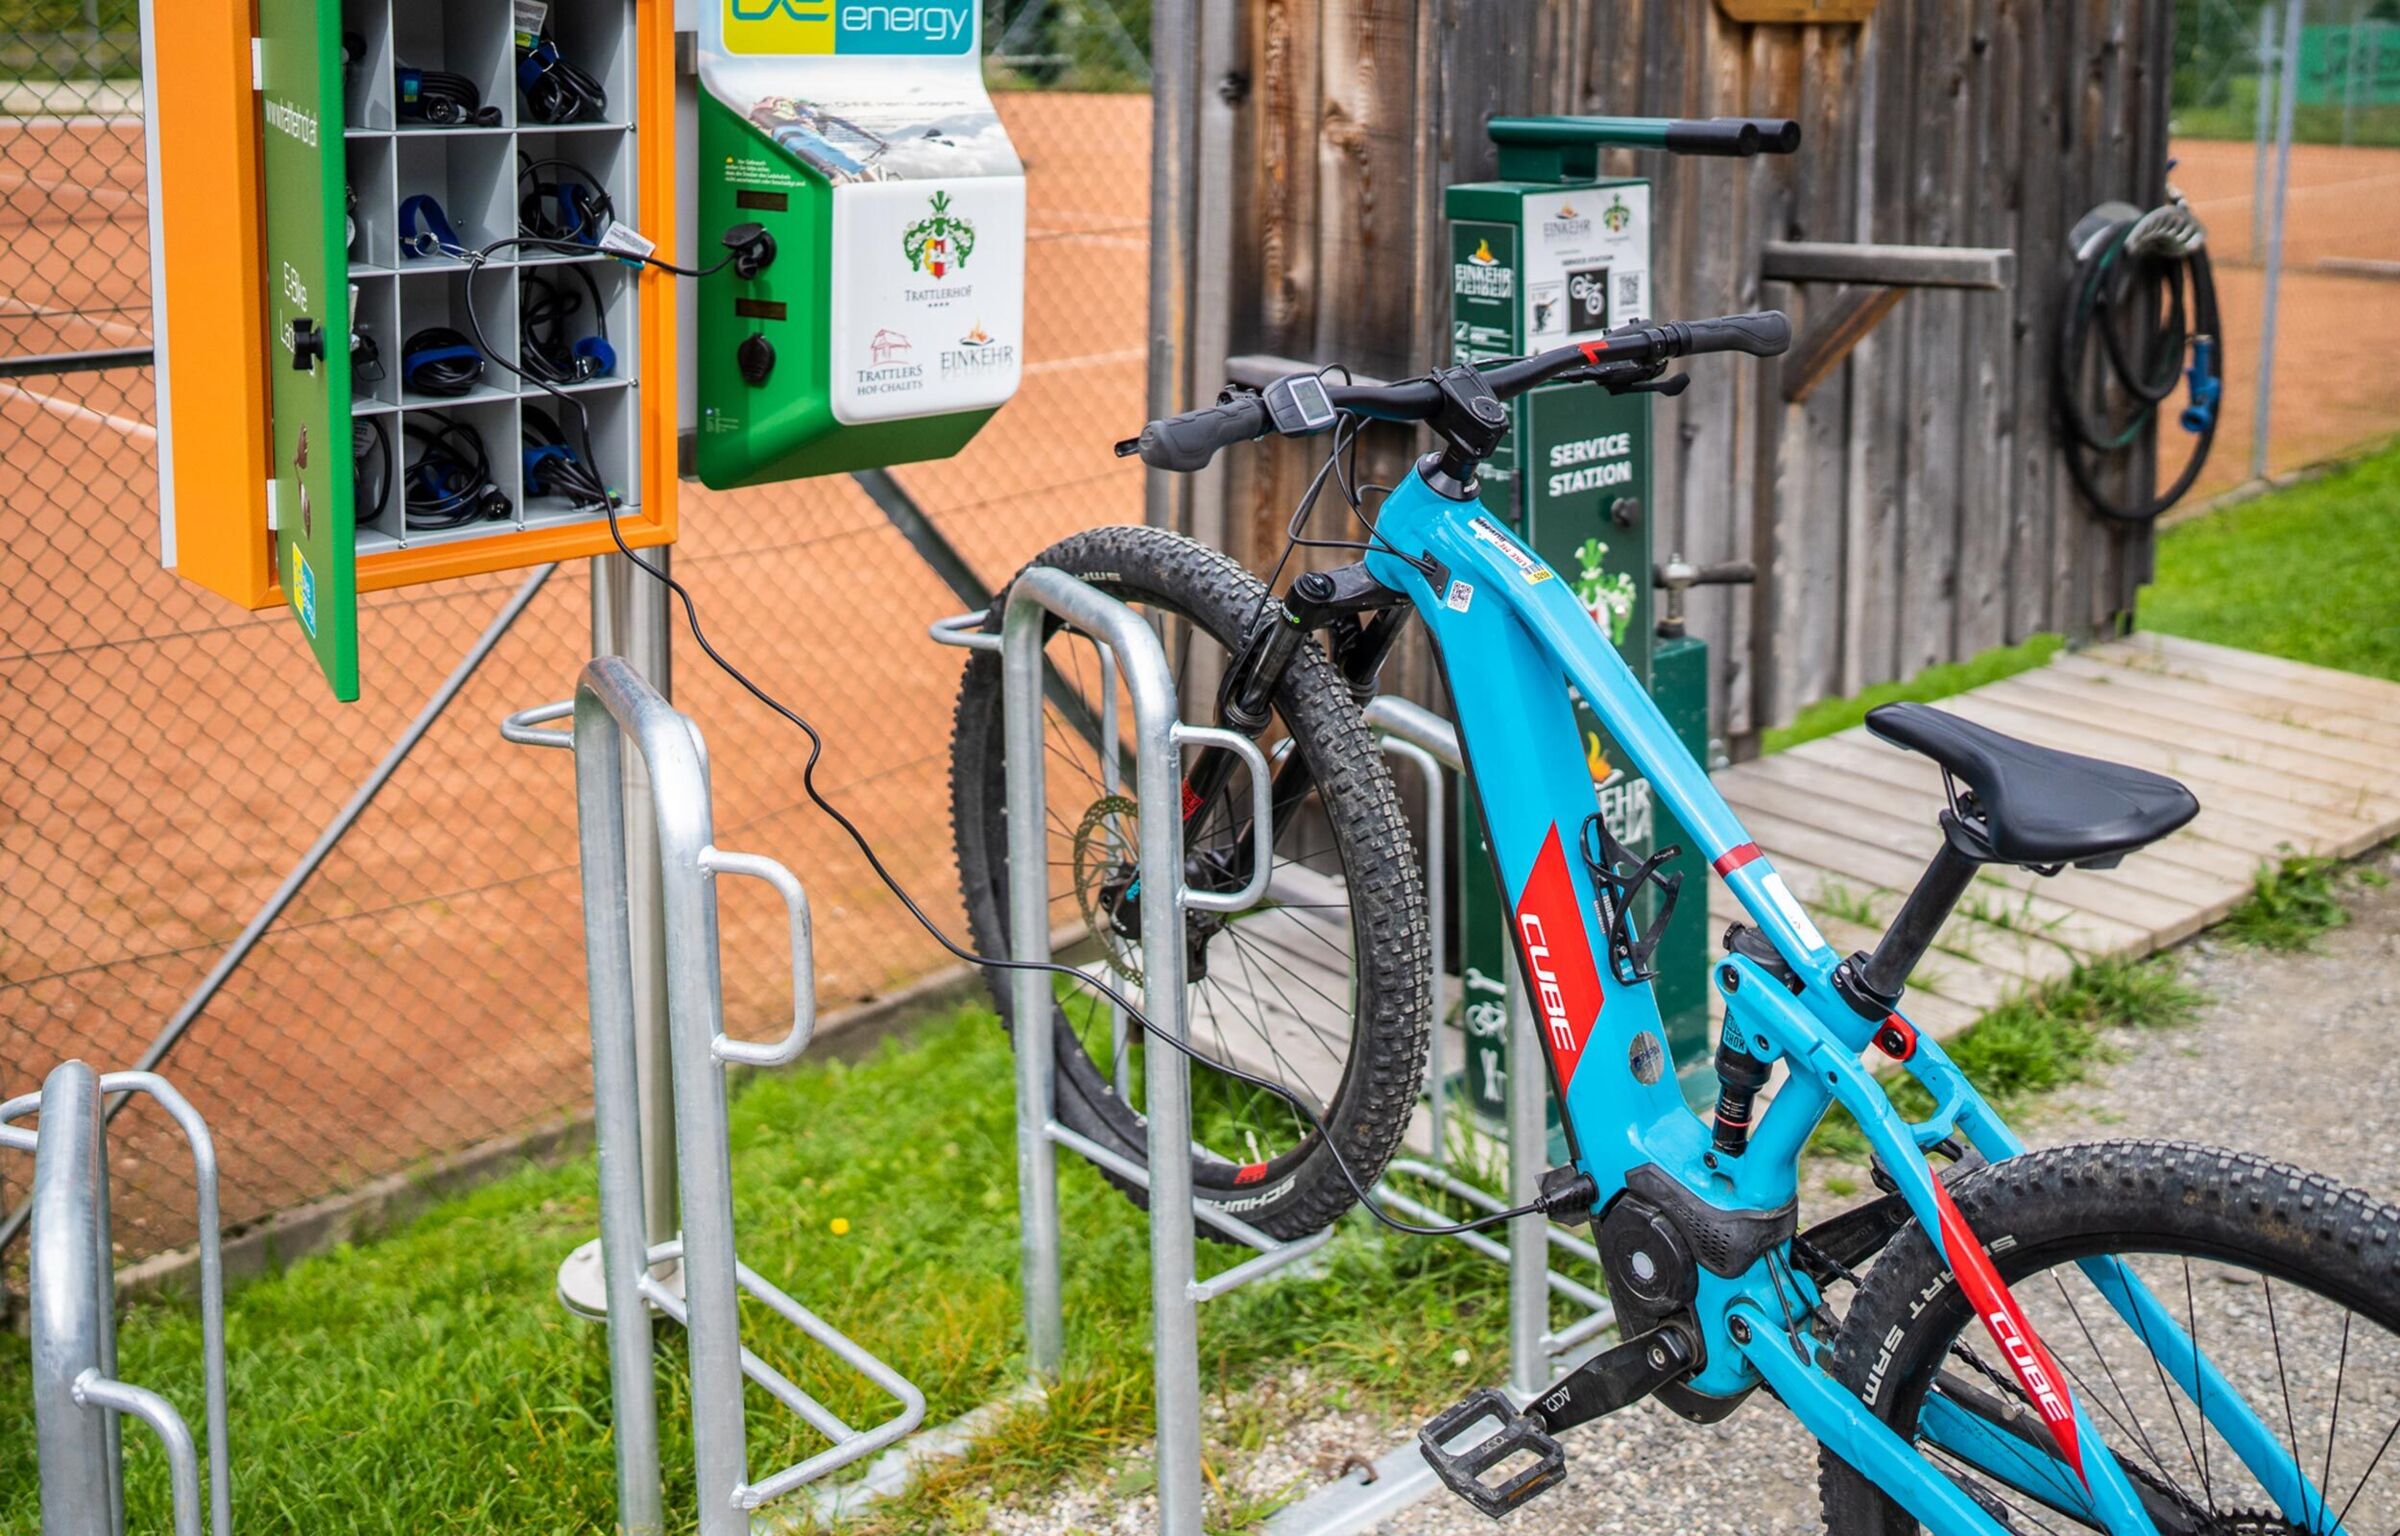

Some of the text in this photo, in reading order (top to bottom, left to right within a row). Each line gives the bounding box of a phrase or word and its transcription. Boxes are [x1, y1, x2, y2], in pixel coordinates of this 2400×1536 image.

[842, 6, 968, 41] energy
[1454, 263, 1512, 283] EINKEHR
[904, 284, 974, 302] TRATTLERHOF
[857, 364, 923, 384] TRATTLERS
[940, 345, 1014, 371] EINKEHR
[1550, 433, 1631, 468] SERVICE
[1549, 461, 1632, 497] STATION
[1520, 912, 1577, 1052] CUBE
[1862, 1323, 1905, 1407] SAM
[1988, 1311, 2070, 1422] CUBE
